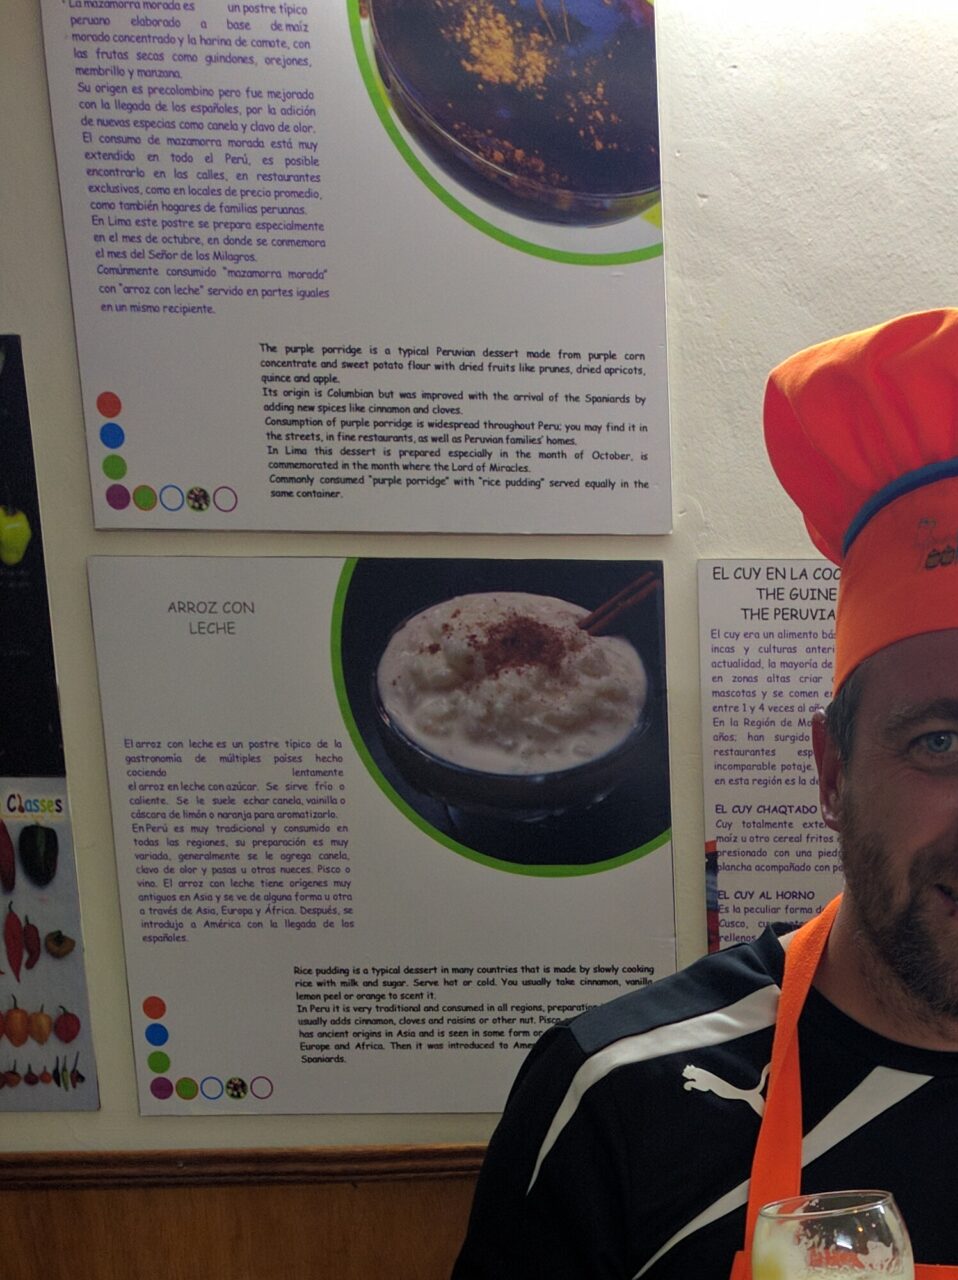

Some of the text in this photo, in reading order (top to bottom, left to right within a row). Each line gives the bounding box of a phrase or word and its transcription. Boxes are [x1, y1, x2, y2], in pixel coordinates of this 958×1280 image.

[77, 81, 314, 102] Su origen es precolombino pero fue mejorado
[91, 214, 324, 232] En Lima este postre se prepara especialmente
[258, 343, 277, 352] The
[284, 344, 314, 355] purple
[321, 344, 362, 356] porridge
[397, 346, 429, 357] typical
[436, 346, 475, 356] Peruvian
[482, 347, 518, 357] dessert
[526, 349, 550, 358] made
[557, 349, 581, 359] from
[587, 350, 617, 362] purple
[712, 566, 842, 581] EL CUY EN LA COC
[755, 587, 837, 601] THE GUINE
[167, 600, 255, 614] ARROZ CON
[740, 607, 836, 621] THE PERUVIA
[188, 621, 236, 634] LECHE
[766, 673, 790, 682] altas
[798, 674, 823, 683] criar
[712, 704, 739, 712] entre
[6, 793, 63, 814] Classes
[715, 804, 819, 816] EL CUY CHAQTADO
[133, 837, 159, 846] todas
[166, 837, 179, 846] las
[330, 839, 349, 848] muy
[717, 890, 815, 900] EL CUY AL HORNO
[293, 966, 313, 974] Rice
[315, 966, 350, 976] pudding
[371, 965, 400, 976] typical
[402, 966, 437, 974] dessert
[451, 967, 474, 975] many
[476, 965, 518, 973] countries
[520, 965, 540, 973] that
[553, 964, 576, 973] made
[578, 965, 590, 975] by
[592, 964, 619, 975] slowly
[621, 964, 654, 975] cooking
